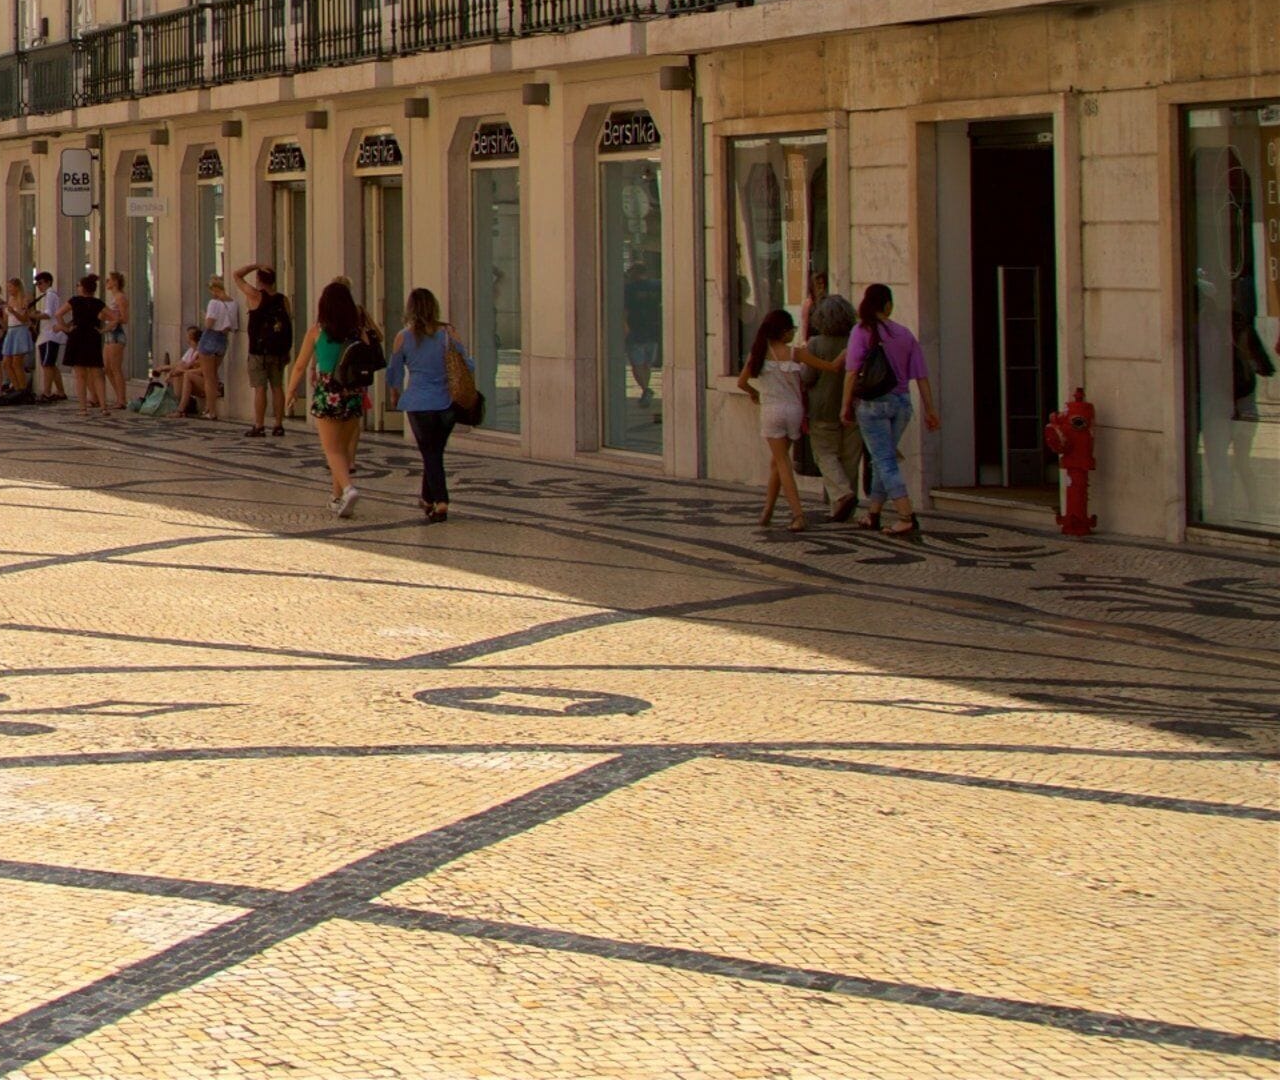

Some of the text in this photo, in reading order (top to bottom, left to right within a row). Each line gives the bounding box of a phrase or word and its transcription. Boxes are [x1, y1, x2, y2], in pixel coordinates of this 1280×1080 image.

[473, 126, 516, 155] Bershka
[603, 114, 655, 146] Bershka
[359, 138, 394, 164] Bershka
[63, 172, 90, 185] P&B
